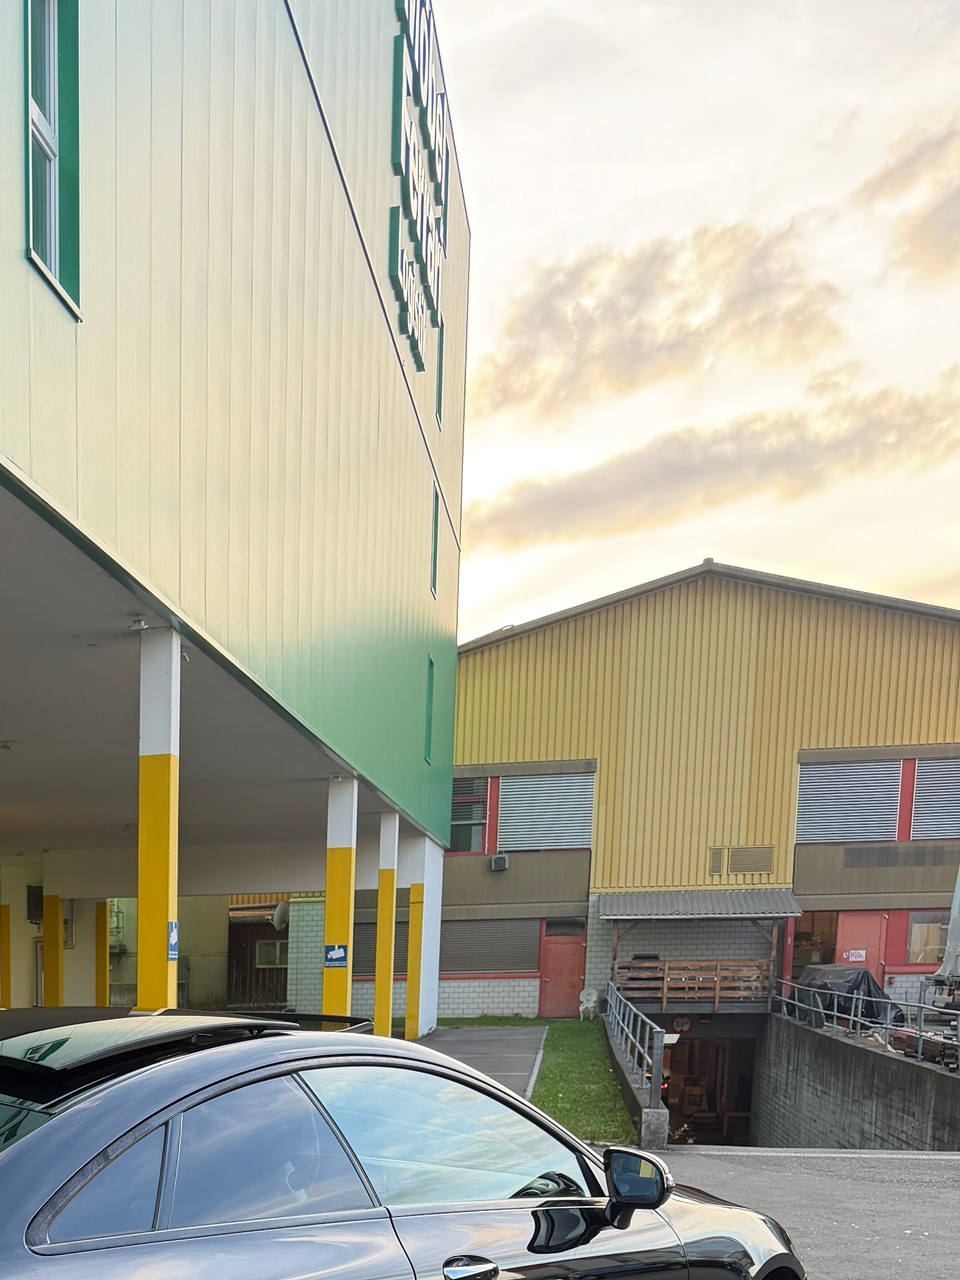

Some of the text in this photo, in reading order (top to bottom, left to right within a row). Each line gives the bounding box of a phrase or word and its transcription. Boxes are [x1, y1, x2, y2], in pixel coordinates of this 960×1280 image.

[400, 33, 445, 328] Ferrari
[404, 0, 448, 207] öbel
[397, 206, 429, 372] Logistik
